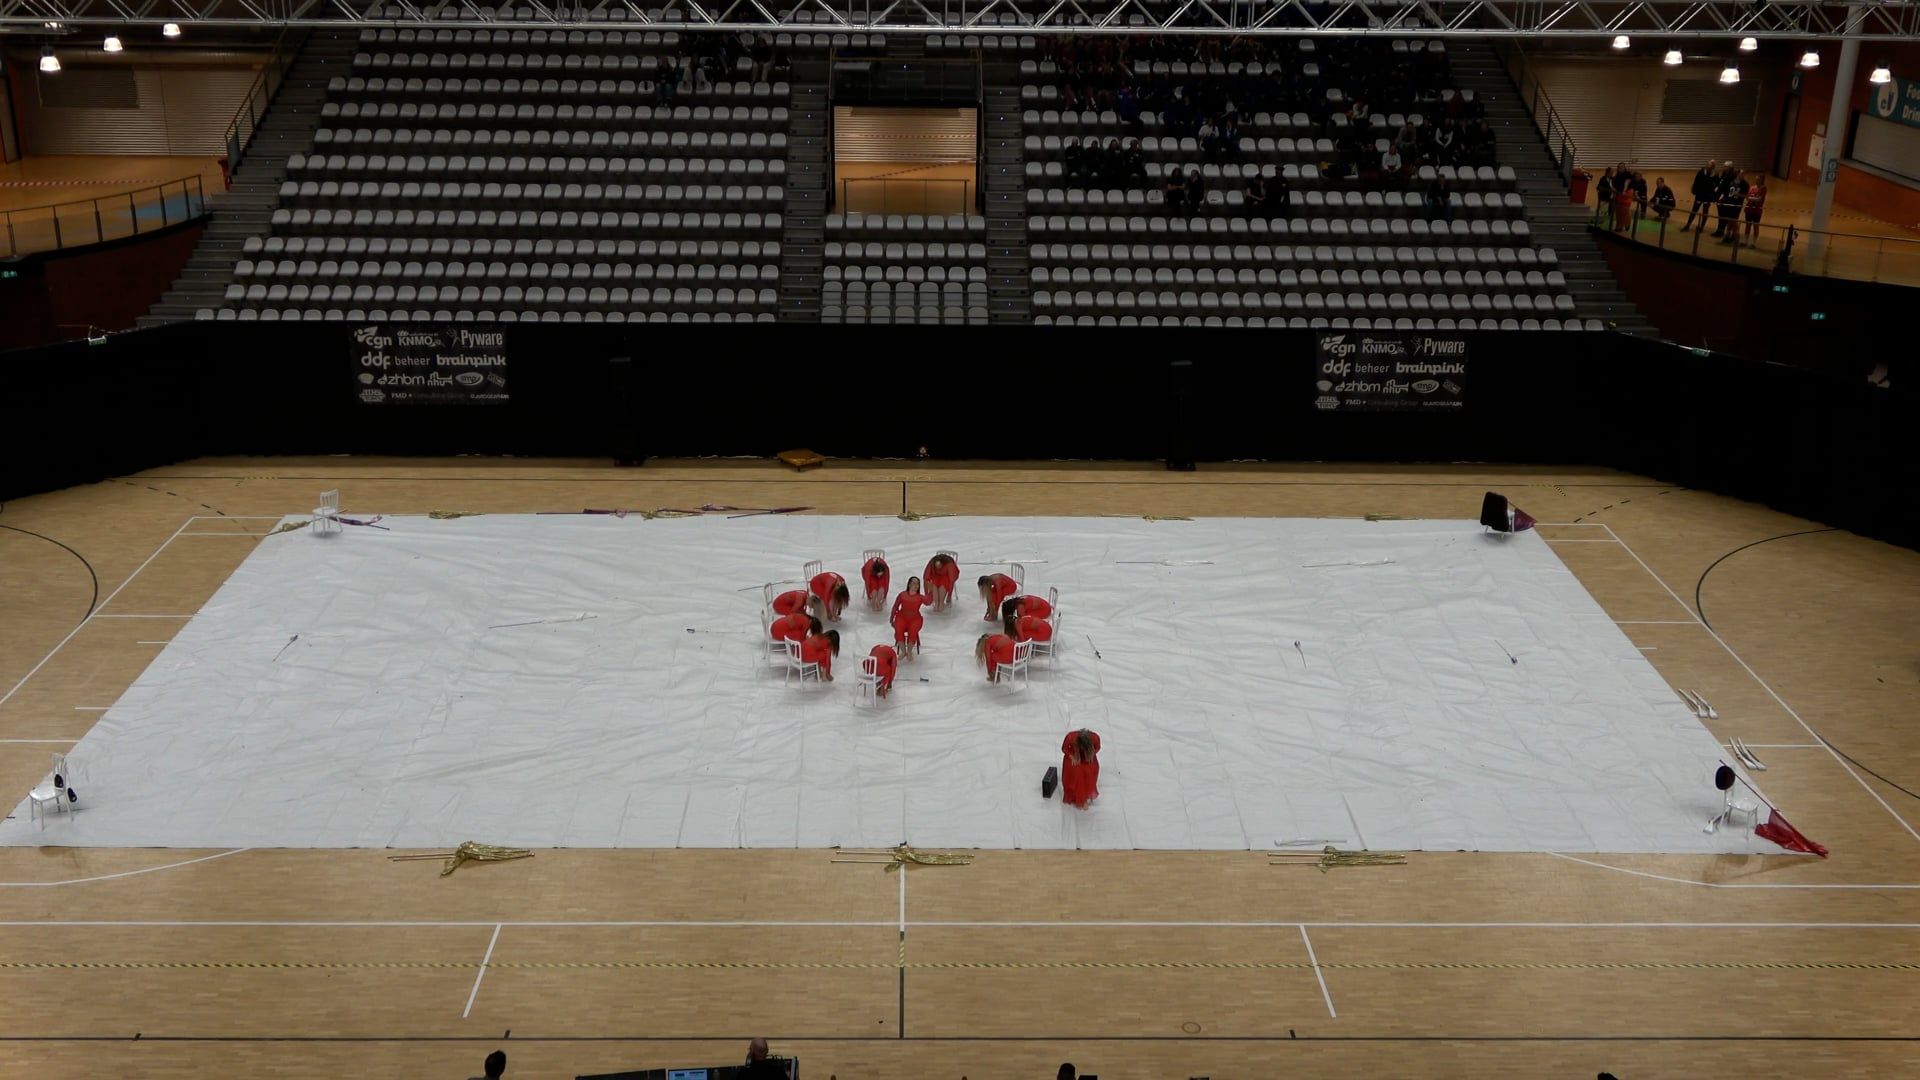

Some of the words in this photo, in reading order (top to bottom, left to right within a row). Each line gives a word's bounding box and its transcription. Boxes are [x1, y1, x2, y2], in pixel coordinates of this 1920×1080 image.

[365, 334, 393, 349] cgn
[398, 335, 433, 346] KNMO
[461, 330, 503, 349] Pyware
[1331, 342, 1356, 356] cgn
[1362, 343, 1396, 354] KNMO
[1424, 338, 1465, 356] Pyware
[361, 351, 391, 369] ddf
[394, 356, 431, 366] beheer
[436, 354, 507, 367] brainpink
[1322, 359, 1351, 377] ddf
[1355, 363, 1390, 373] beheer
[1395, 362, 1465, 375] brainpink
